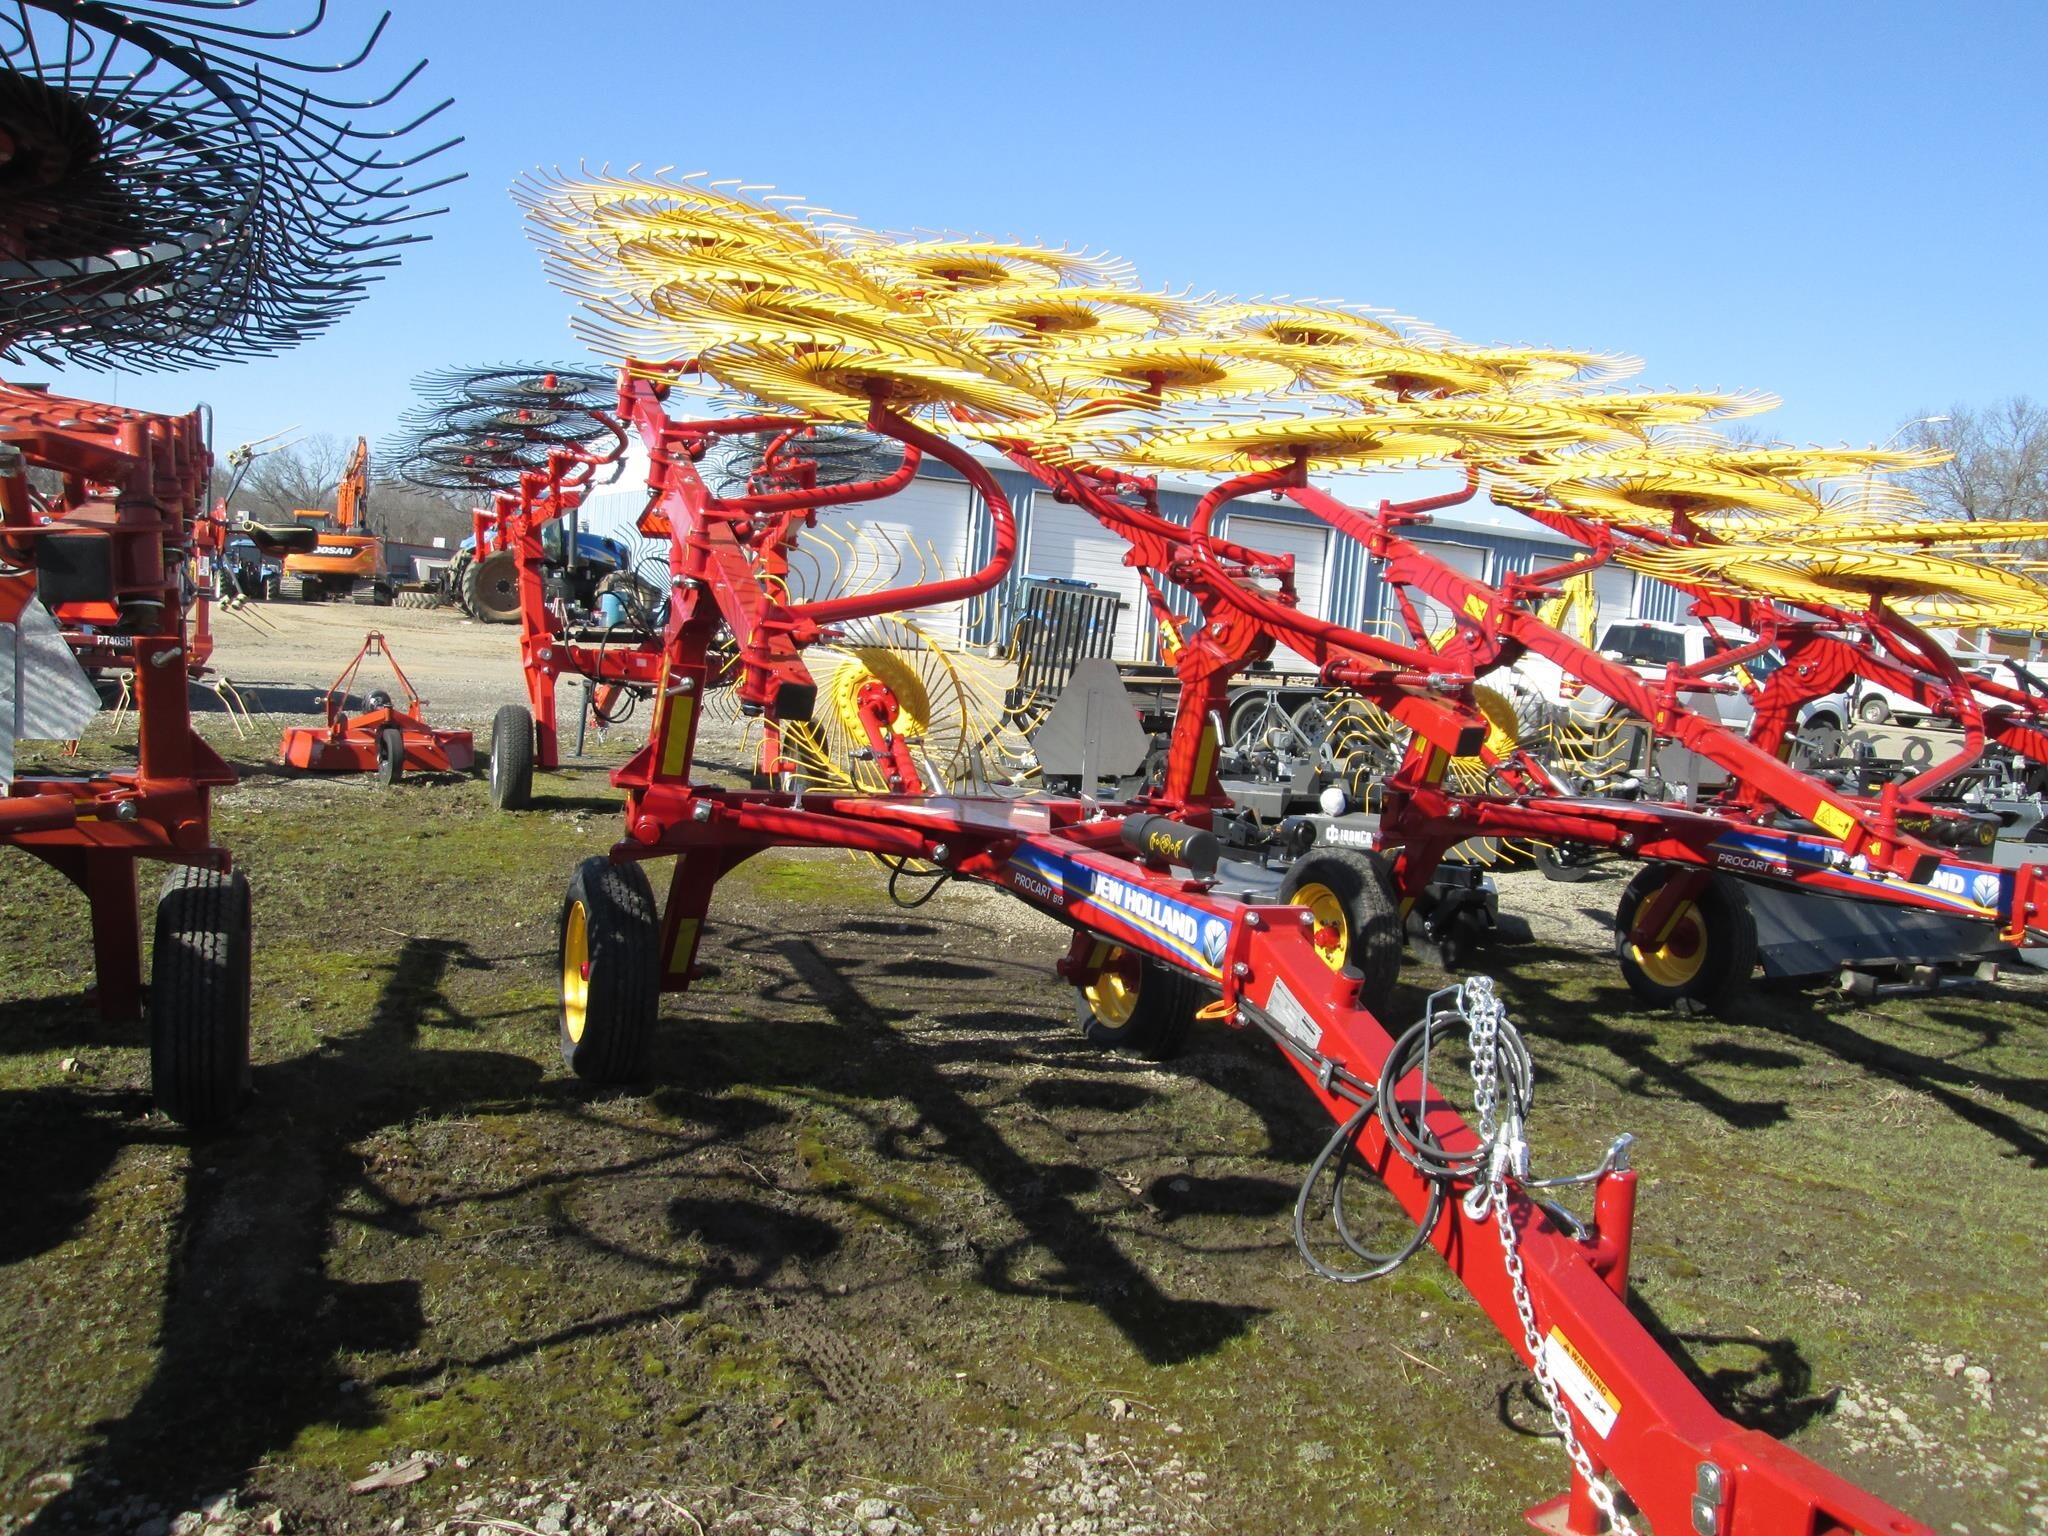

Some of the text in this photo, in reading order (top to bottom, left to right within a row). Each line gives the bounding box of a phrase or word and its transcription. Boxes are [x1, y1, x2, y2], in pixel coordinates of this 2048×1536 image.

[96, 635, 133, 647] PT405H
[1716, 853, 1771, 872] PROCART
[1014, 872, 1052, 899] PROCART
[1090, 872, 1198, 945] NEW HOLLAND
[1571, 1350, 1607, 1396] WARNING
